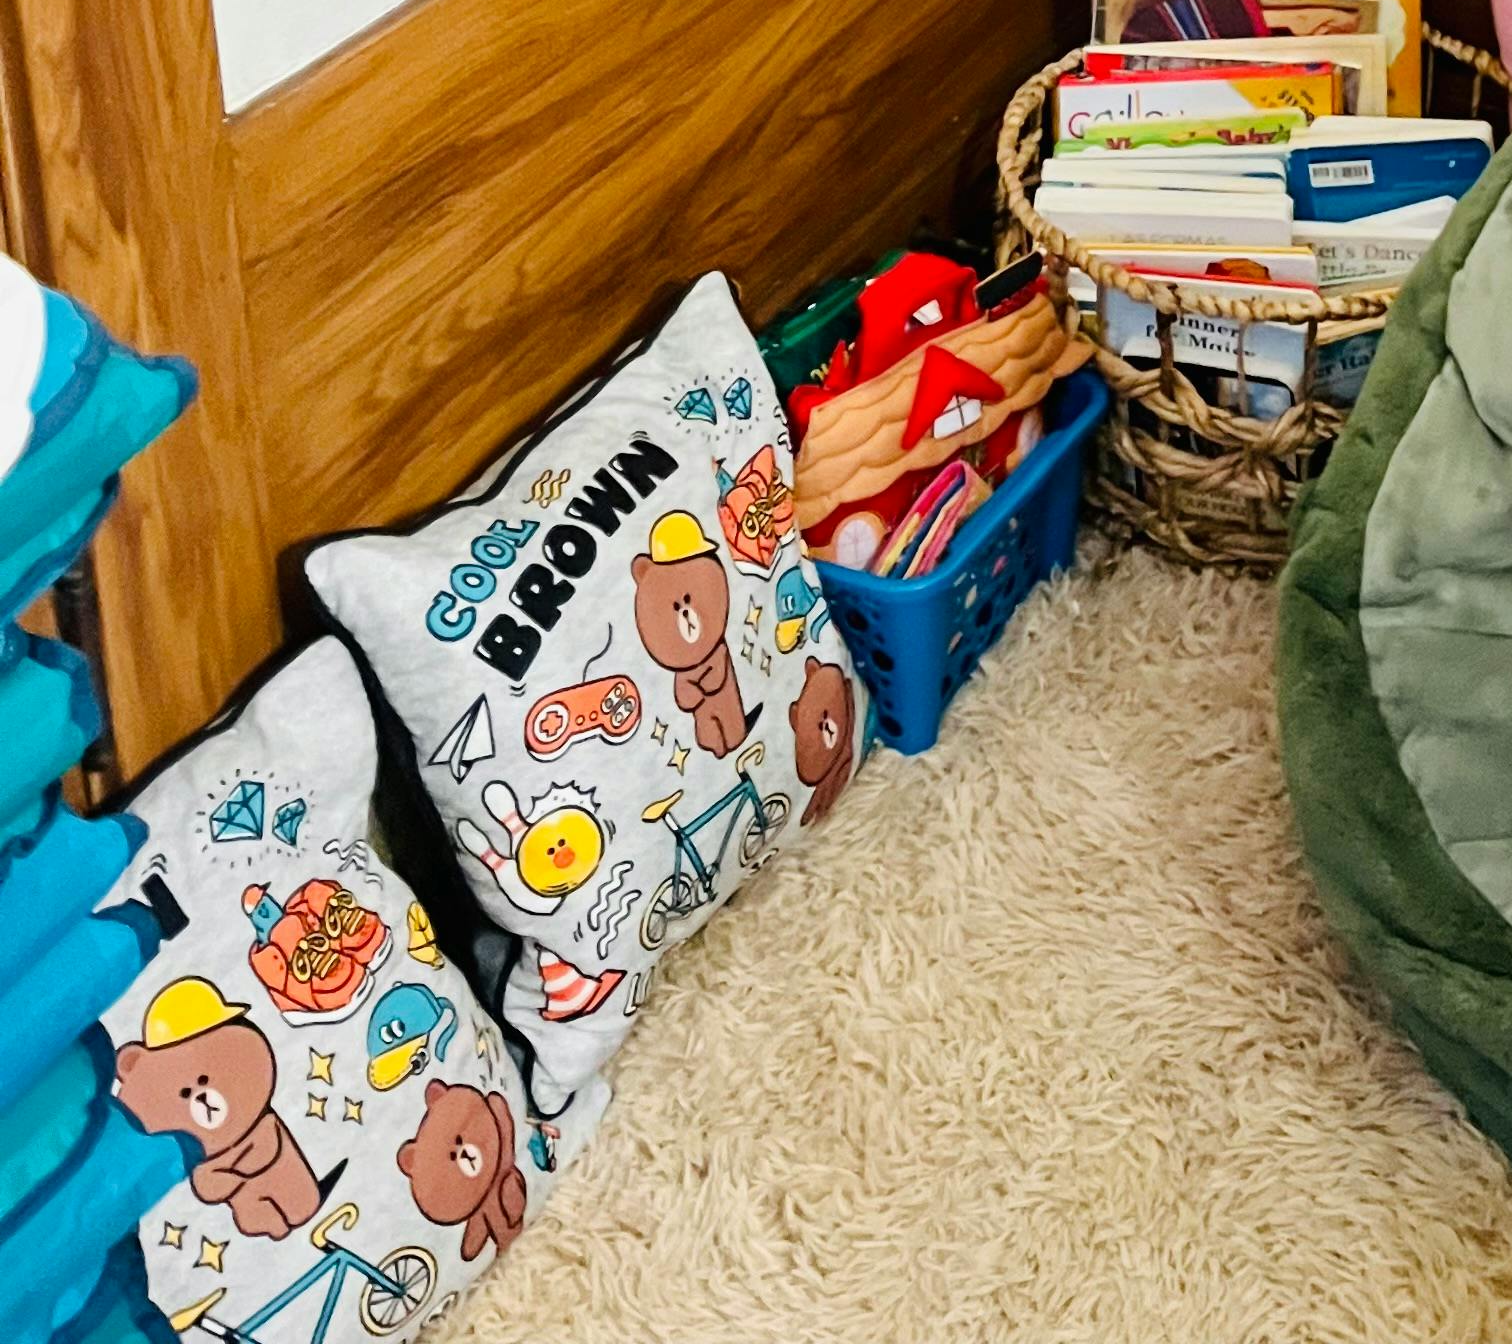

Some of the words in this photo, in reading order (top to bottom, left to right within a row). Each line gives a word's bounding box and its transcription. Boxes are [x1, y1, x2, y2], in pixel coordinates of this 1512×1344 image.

[1177, 316, 1241, 338] inner
[425, 518, 541, 643] COOL
[472, 439, 680, 682] BROWN
